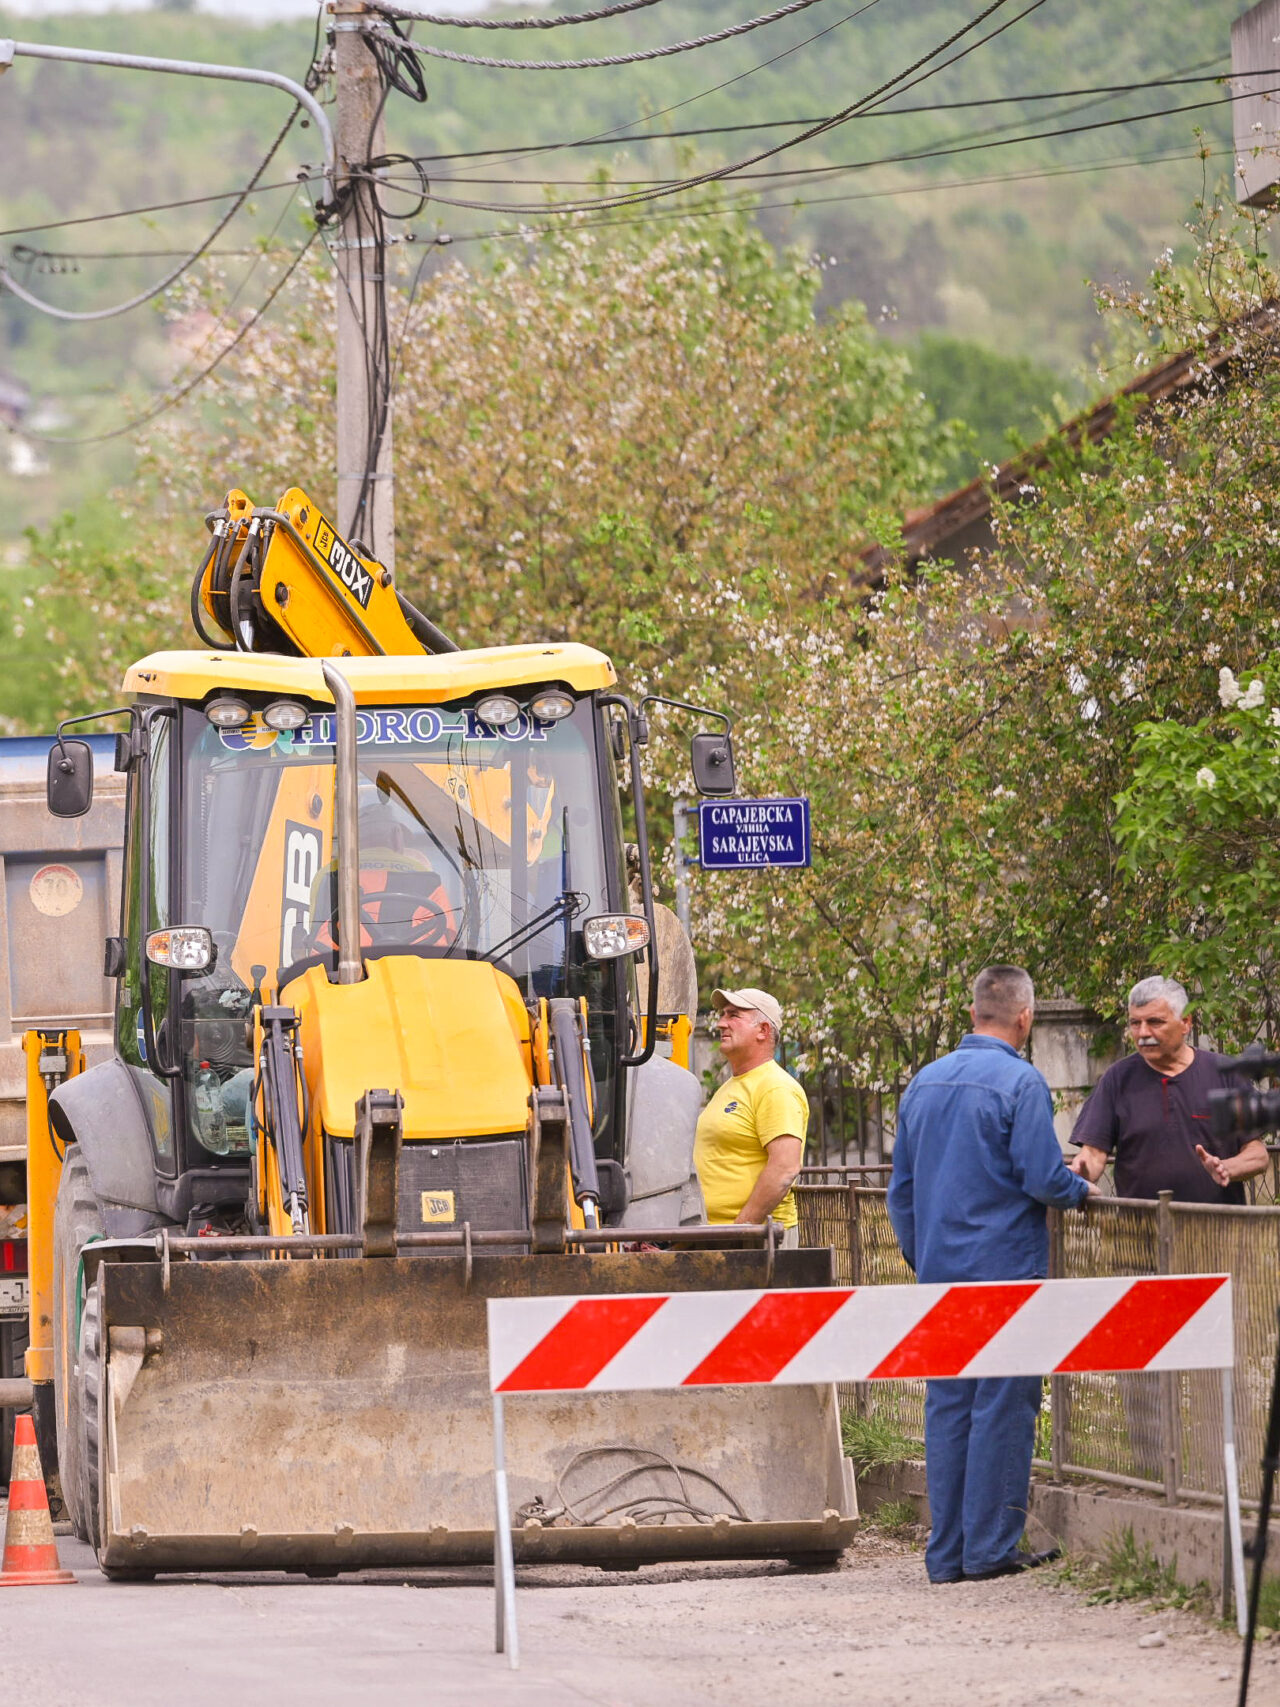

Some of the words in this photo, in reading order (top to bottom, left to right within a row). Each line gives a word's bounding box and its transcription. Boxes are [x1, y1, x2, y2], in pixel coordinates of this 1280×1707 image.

[711, 806, 793, 824] САРАЈЕВСКА
[736, 824, 770, 833] УЛИЦА
[712, 835, 794, 853] SARAJEVSKA
[737, 853, 770, 862] ULICA
[429, 1199, 449, 1214] JCB
